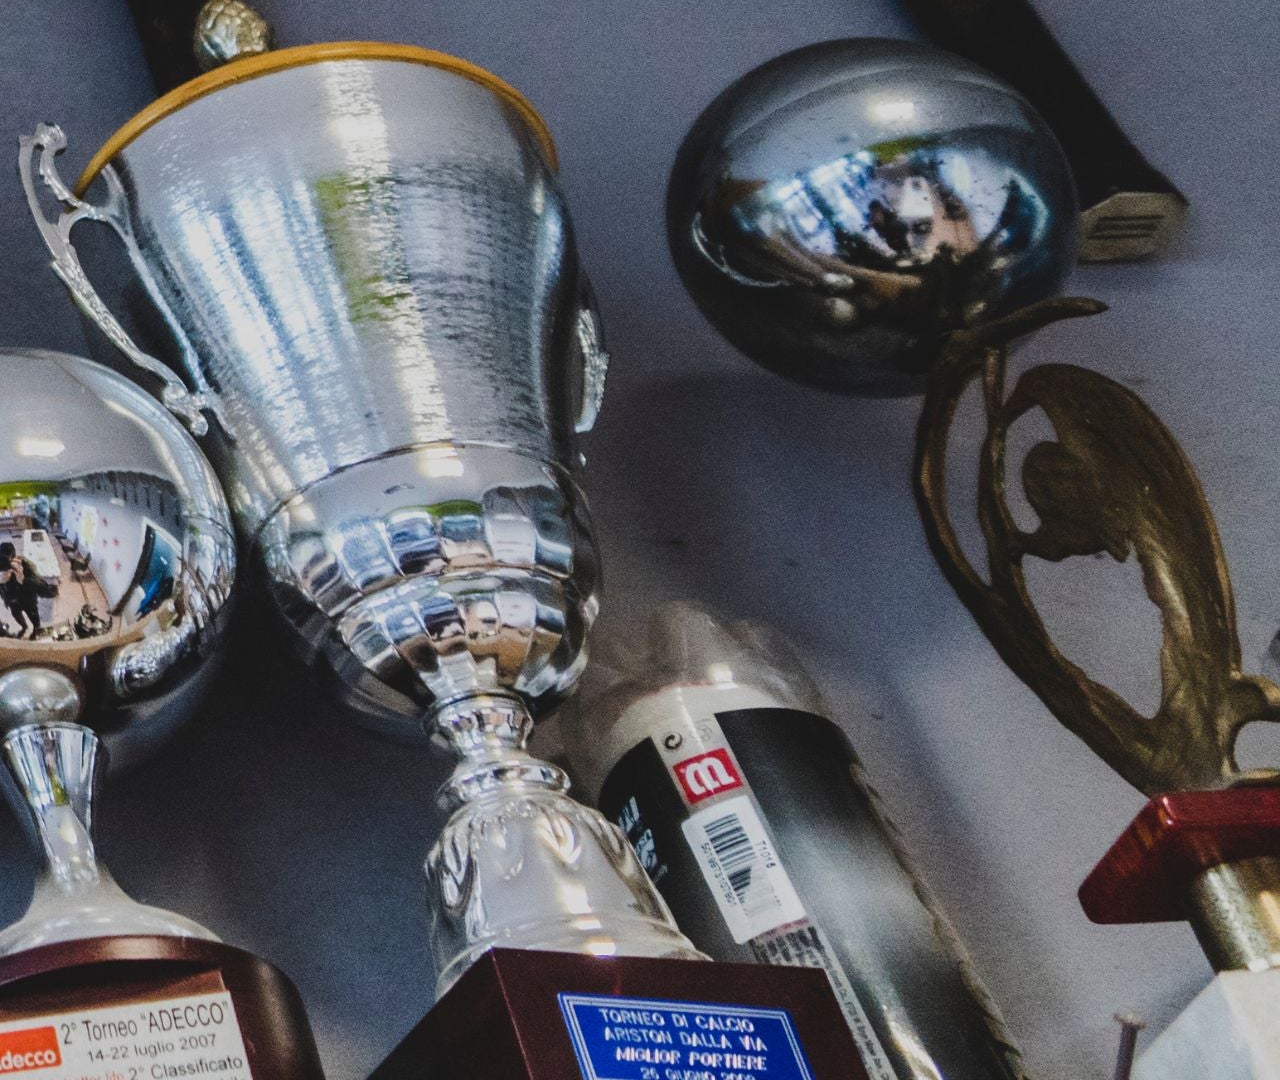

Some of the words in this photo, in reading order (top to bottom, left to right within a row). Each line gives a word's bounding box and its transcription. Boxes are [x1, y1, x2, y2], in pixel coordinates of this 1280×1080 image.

[83, 1018, 138, 1042] Torneo
[140, 1001, 228, 1034] "ADECCO"
[598, 1008, 666, 1027] TORNEO
[672, 1013, 690, 1029] DI
[695, 1016, 755, 1033] CALCIO
[87, 1046, 130, 1063] 14-22
[134, 1040, 175, 1058] luglio
[179, 1033, 216, 1051] 2007
[604, 1026, 672, 1045] ARISTON
[680, 1032, 732, 1049] DALLA
[738, 1035, 768, 1052] VIA
[151, 1055, 243, 1080] Classificato
[615, 1046, 681, 1066] MIGLIOR
[689, 1052, 768, 1071] PORTIERE
